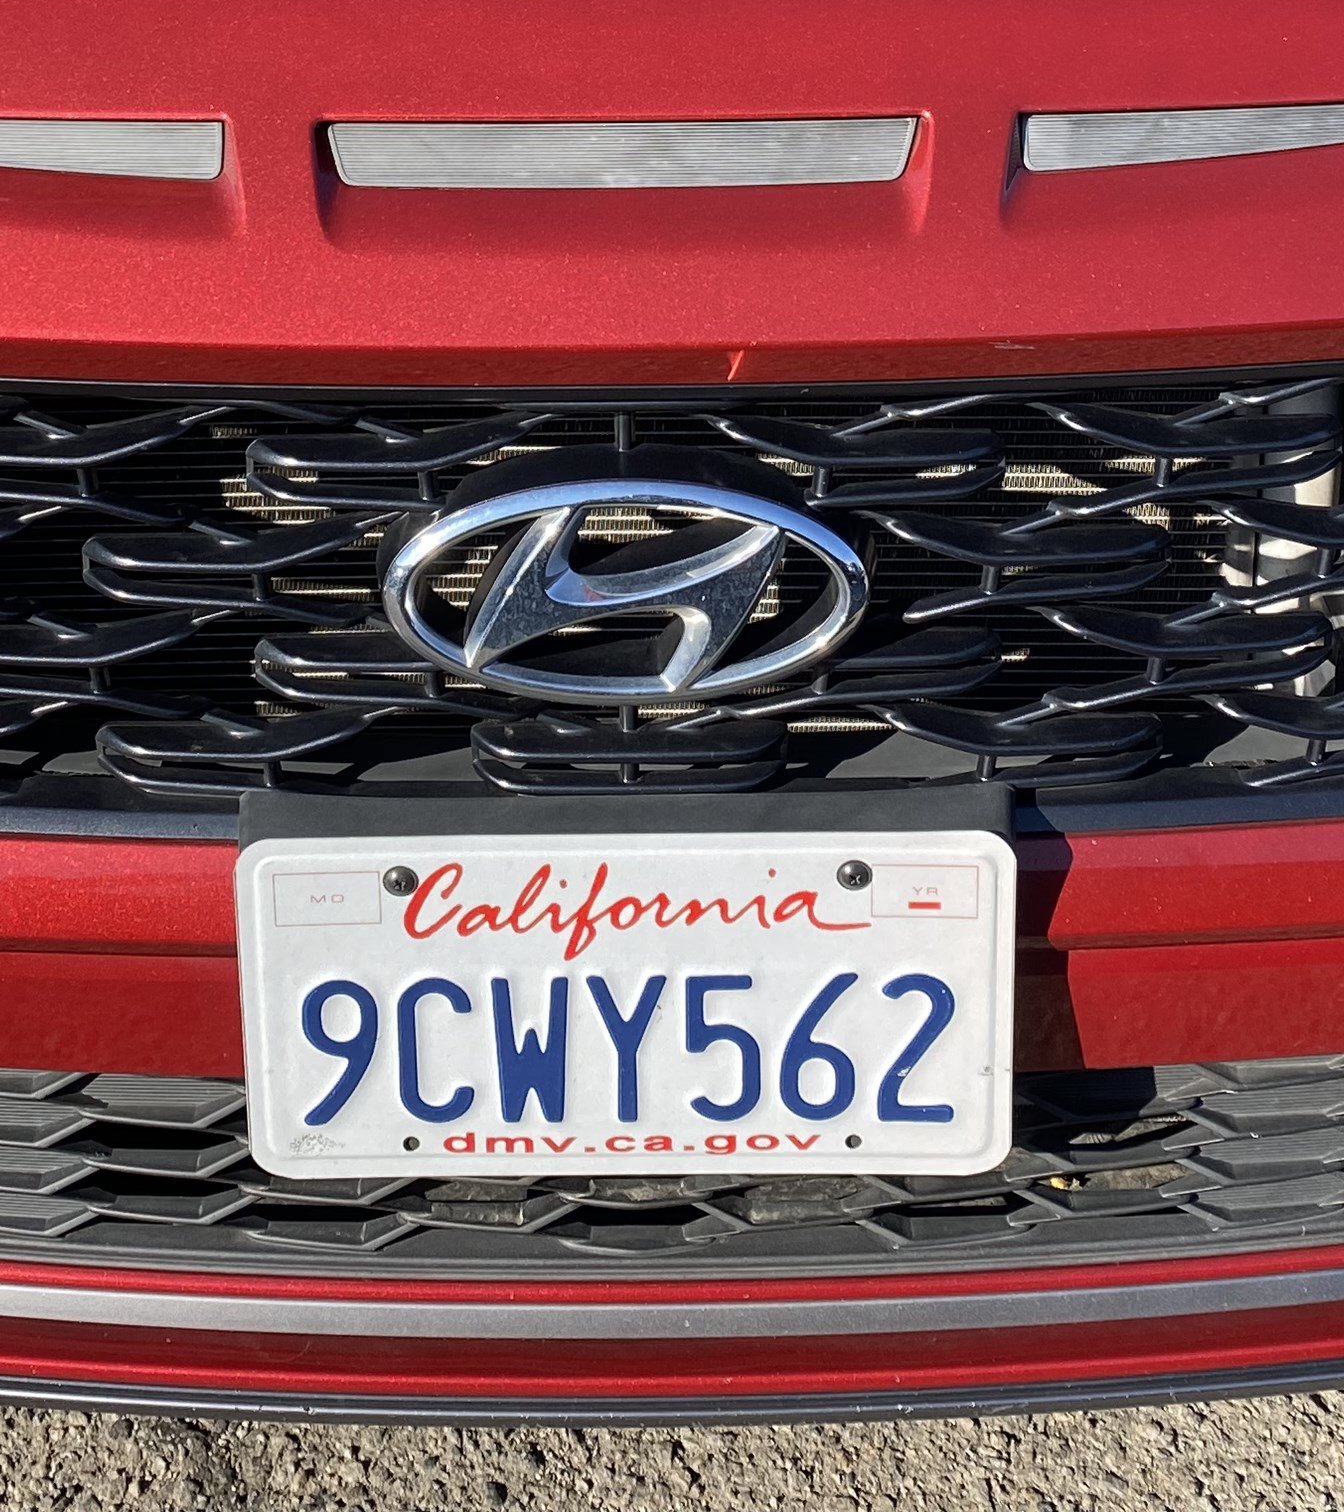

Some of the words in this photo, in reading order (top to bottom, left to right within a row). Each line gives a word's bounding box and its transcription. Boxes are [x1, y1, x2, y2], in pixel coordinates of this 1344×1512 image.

[310, 894, 345, 904] MO
[912, 886, 939, 896] YR
[404, 862, 872, 961] California
[301, 974, 956, 1127] 9CWY562
[443, 1132, 821, 1155] dmv.ca.gov
